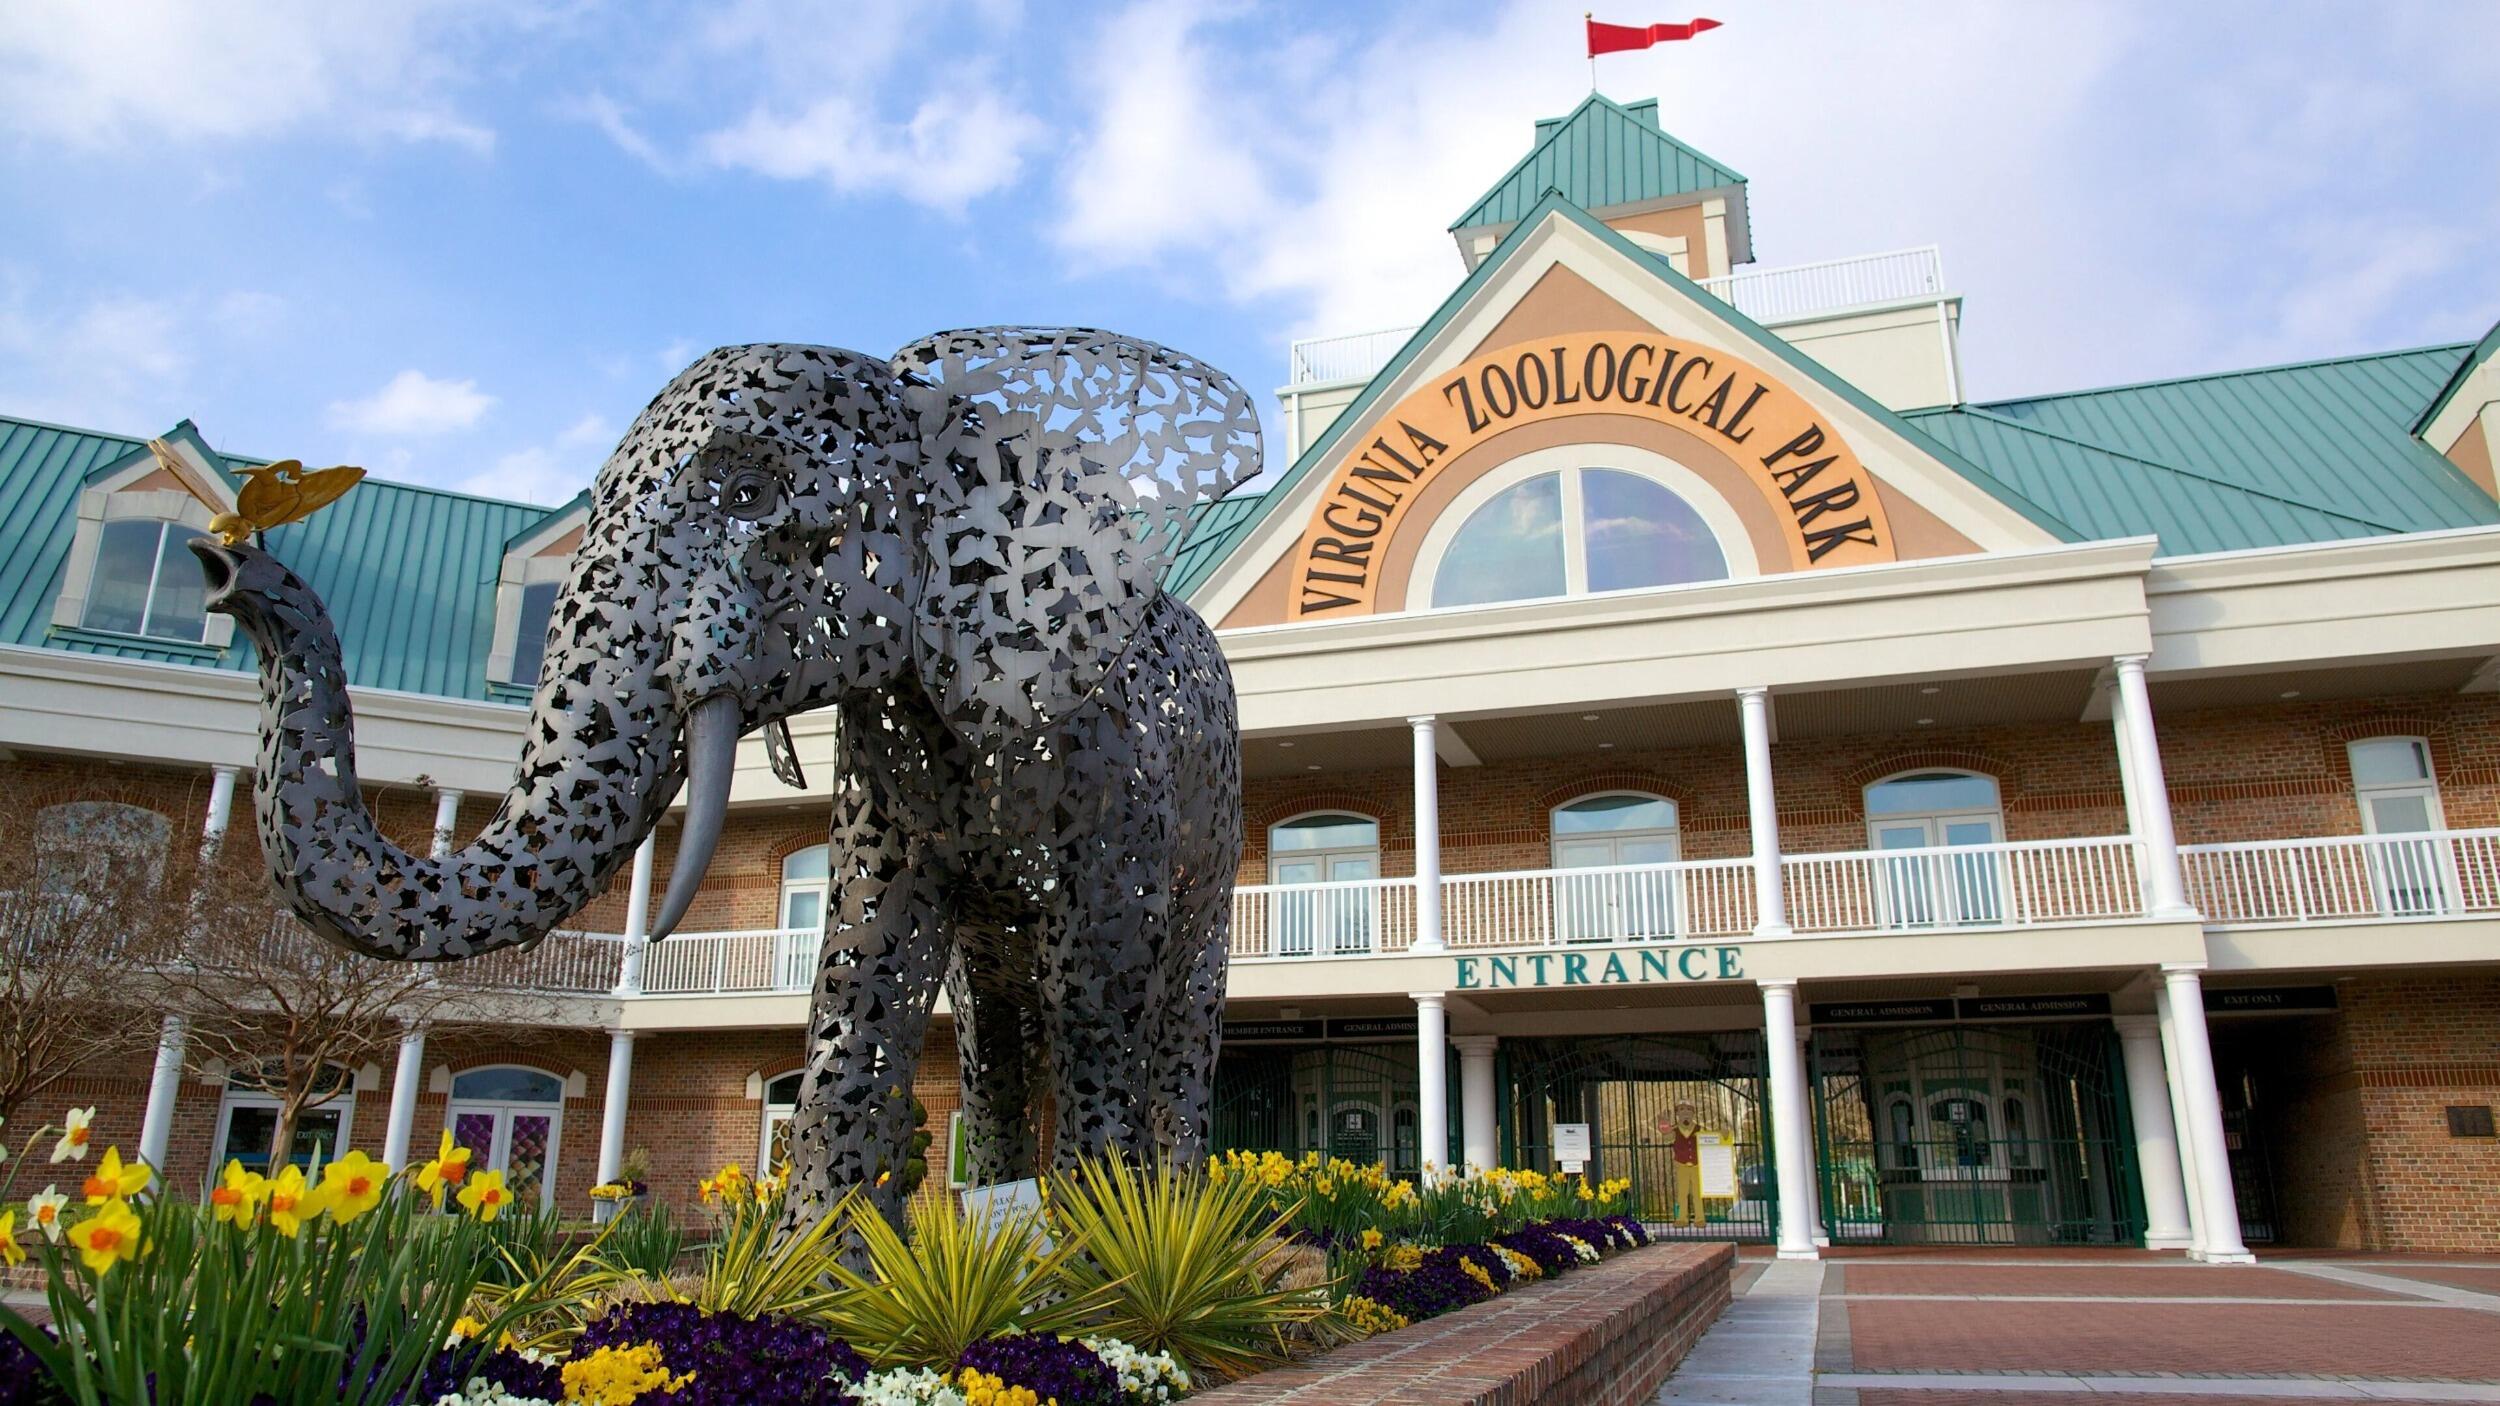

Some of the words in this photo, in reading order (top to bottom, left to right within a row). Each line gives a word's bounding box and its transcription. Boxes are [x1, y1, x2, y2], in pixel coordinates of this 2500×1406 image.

[1301, 419, 1449, 616] VIRGINIA
[1443, 342, 1770, 444] ZOOLOGICAL
[1760, 422, 1878, 564] PARK
[1455, 946, 1744, 989] ENTRANCE
[2223, 995, 2249, 1005] EXIT
[2251, 993, 2283, 1004] ONLY
[1830, 1007, 1876, 1017] GENERAL
[1879, 1005, 1933, 1016] ADMISSION
[1980, 1003, 2028, 1013] GENERAL
[2031, 1000, 2088, 1011] ADMISSION
[1223, 1027, 1259, 1035] MEMBER
[1260, 1026, 1304, 1034] ENTRANCE
[1344, 1023, 1383, 1032] GENERAL
[1385, 1022, 1418, 1031] ADMISS
